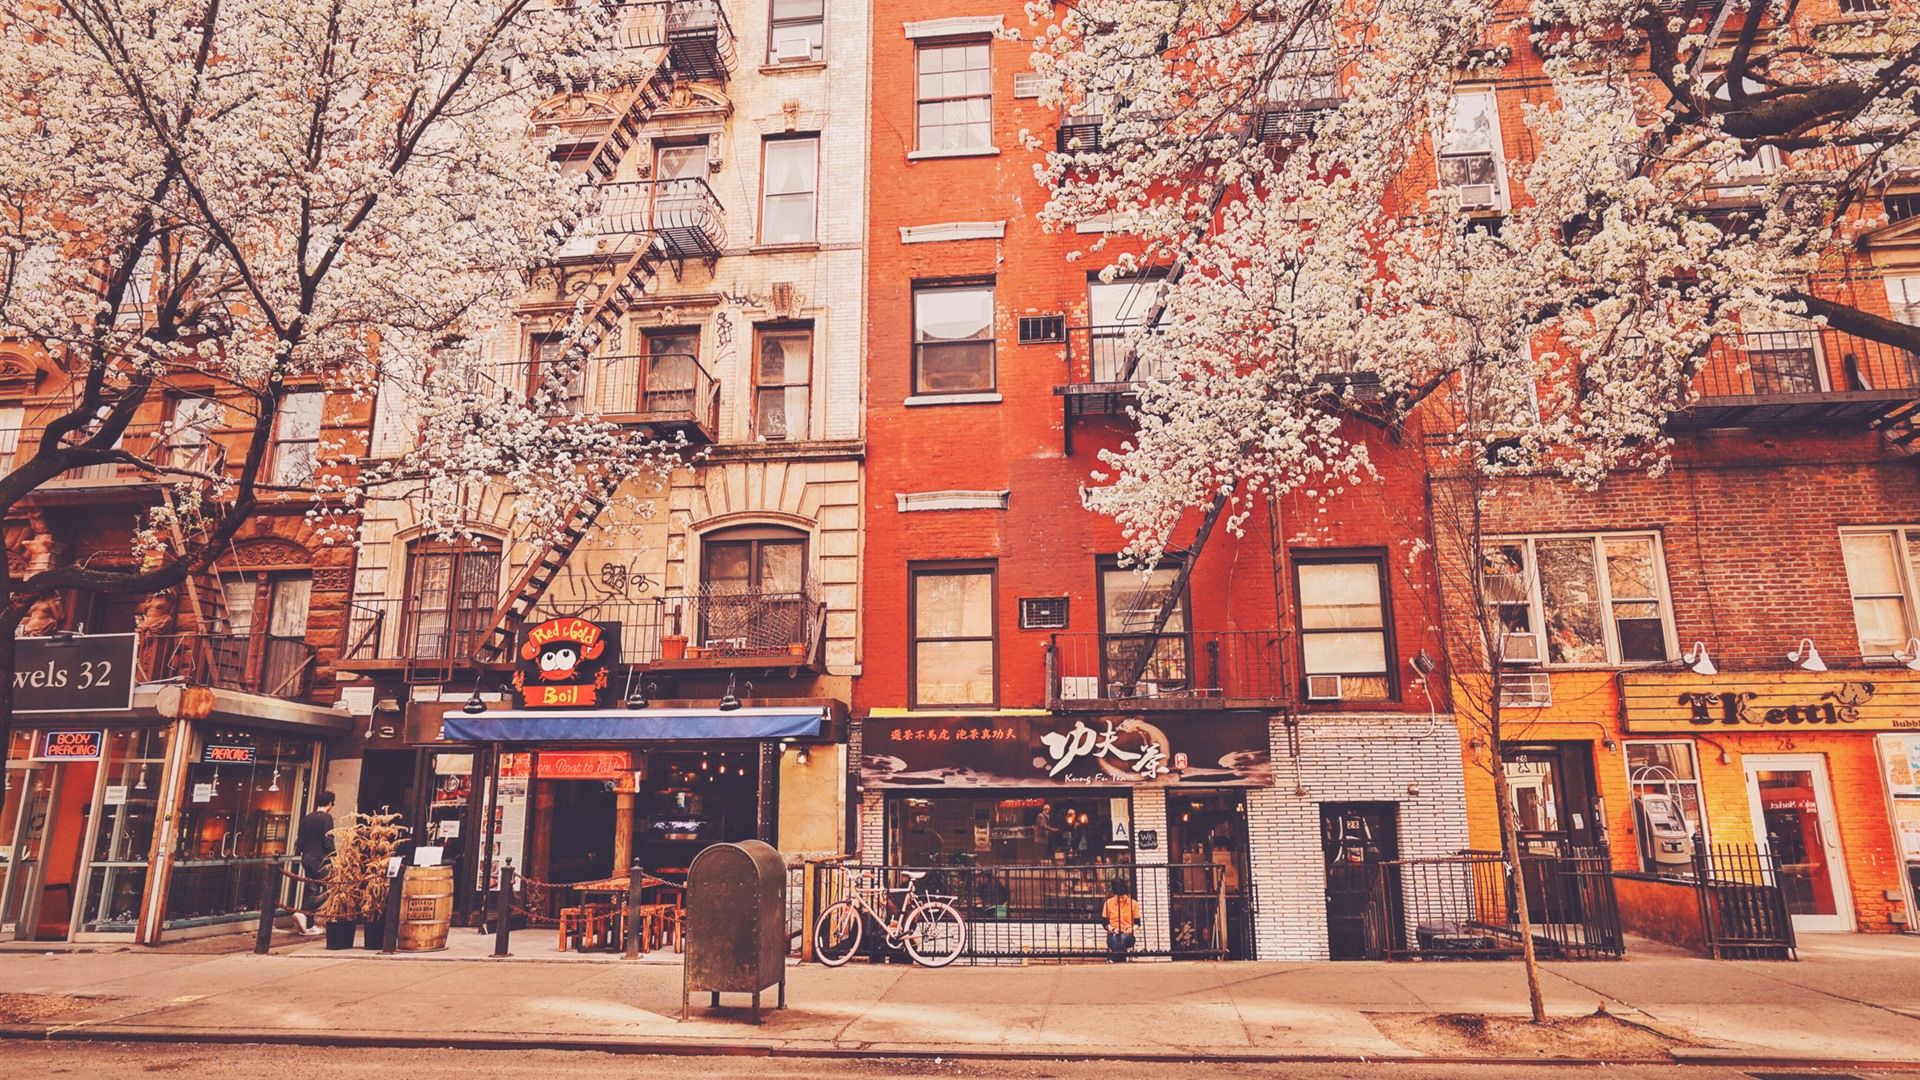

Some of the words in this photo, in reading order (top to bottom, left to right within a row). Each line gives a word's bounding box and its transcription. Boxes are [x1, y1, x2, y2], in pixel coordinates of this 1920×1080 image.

[532, 620, 559, 643] Red
[570, 620, 597, 644] Gold
[12, 660, 68, 689] wels
[77, 660, 112, 690] 32
[543, 685, 578, 704] Boil
[57, 734, 91, 744] BODY
[1777, 737, 1796, 750] 26
[48, 744, 97, 756] PIERCING
[211, 748, 249, 760] PIERCING
[556, 758, 582, 773] Boat
[583, 760, 594, 773] to
[1064, 773, 1091, 785] Kung
[1094, 773, 1108, 782] Fu
[1116, 822, 1126, 835] A
